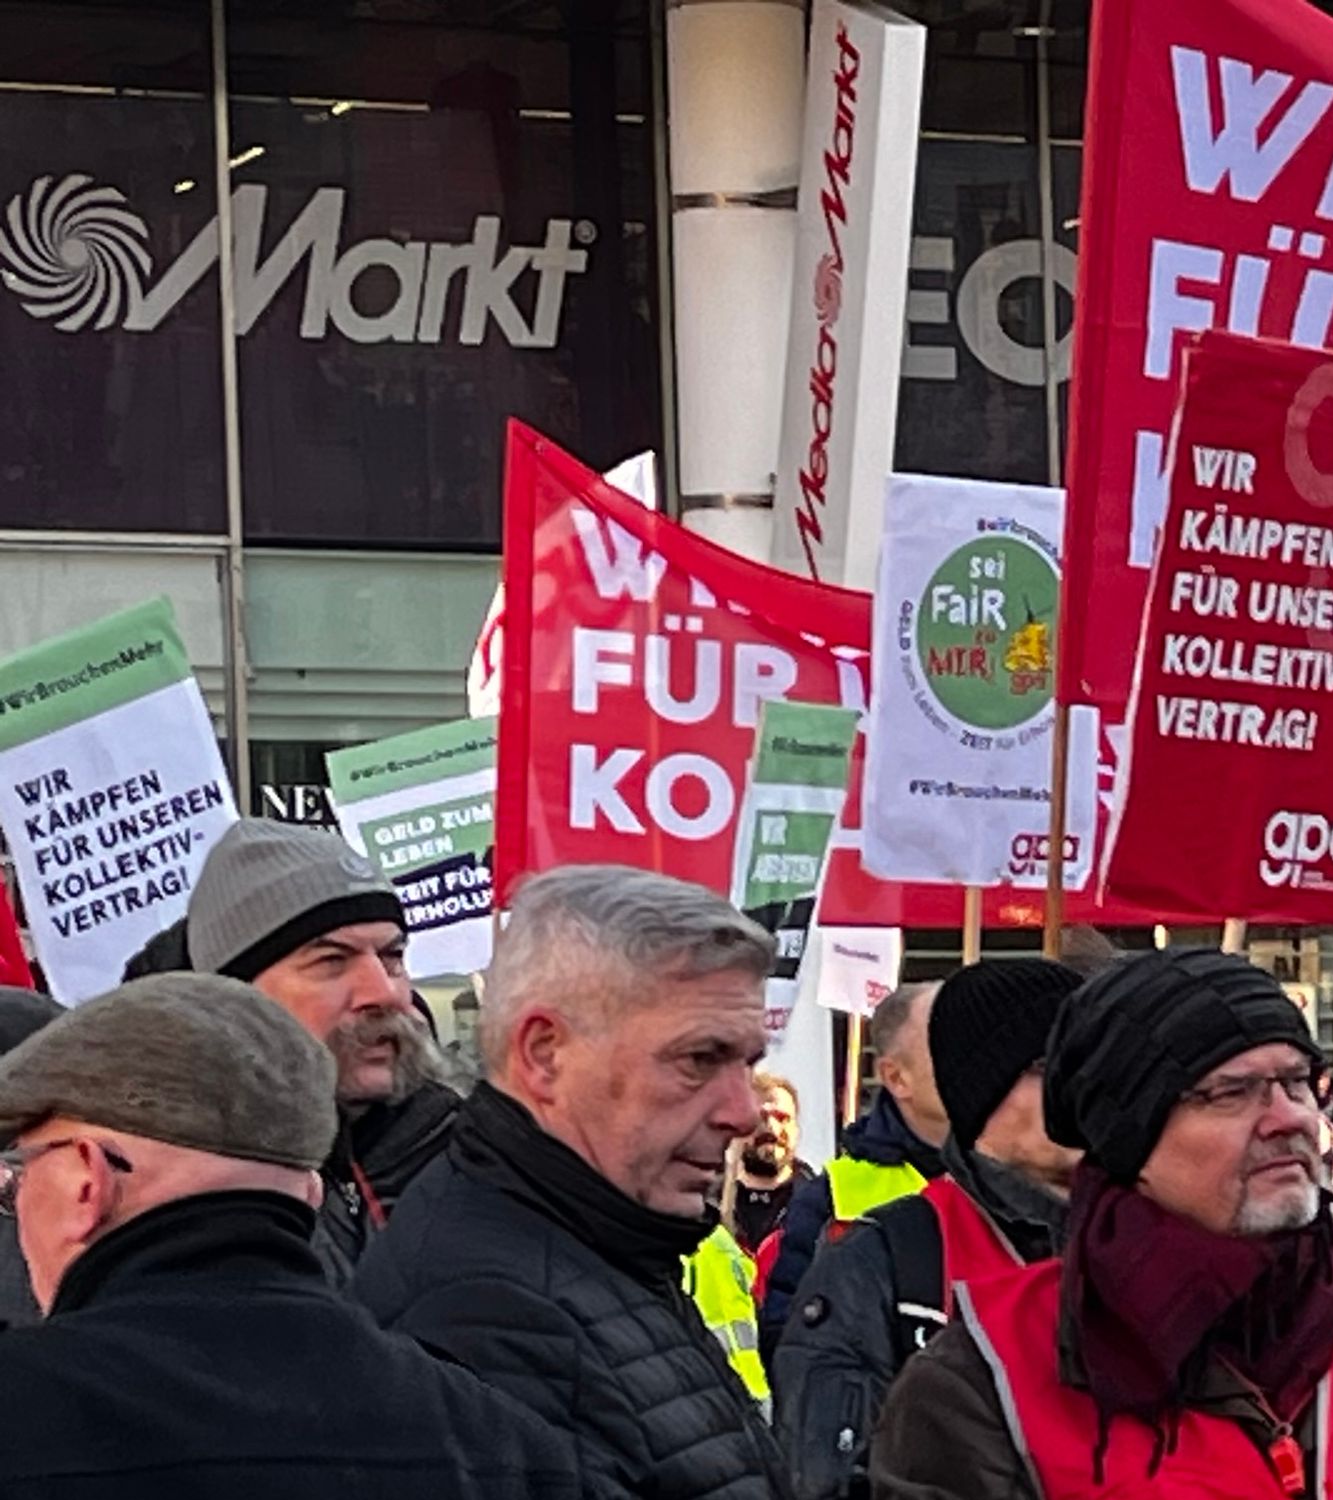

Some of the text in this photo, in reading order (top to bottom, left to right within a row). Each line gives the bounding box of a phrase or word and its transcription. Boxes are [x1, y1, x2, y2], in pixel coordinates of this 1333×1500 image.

[123, 184, 588, 349] Markt
[1192, 445, 1257, 494] WIR
[968, 550, 1007, 581] sei
[1170, 564, 1240, 619] FÜR
[931, 582, 1008, 632] FaiR
[571, 613, 798, 728] FÜR
[1156, 695, 1318, 751] VERTRAG!
[14, 767, 73, 807] WIR
[24, 769, 163, 843] KÄMPFEN
[34, 779, 225, 876] FÜR UNSEREN
[374, 802, 494, 846] GELD ZUM
[42, 827, 205, 908] KOLLEKTIV-
[379, 835, 454, 869] LEBEN
[50, 865, 191, 938] VERTRAG!
